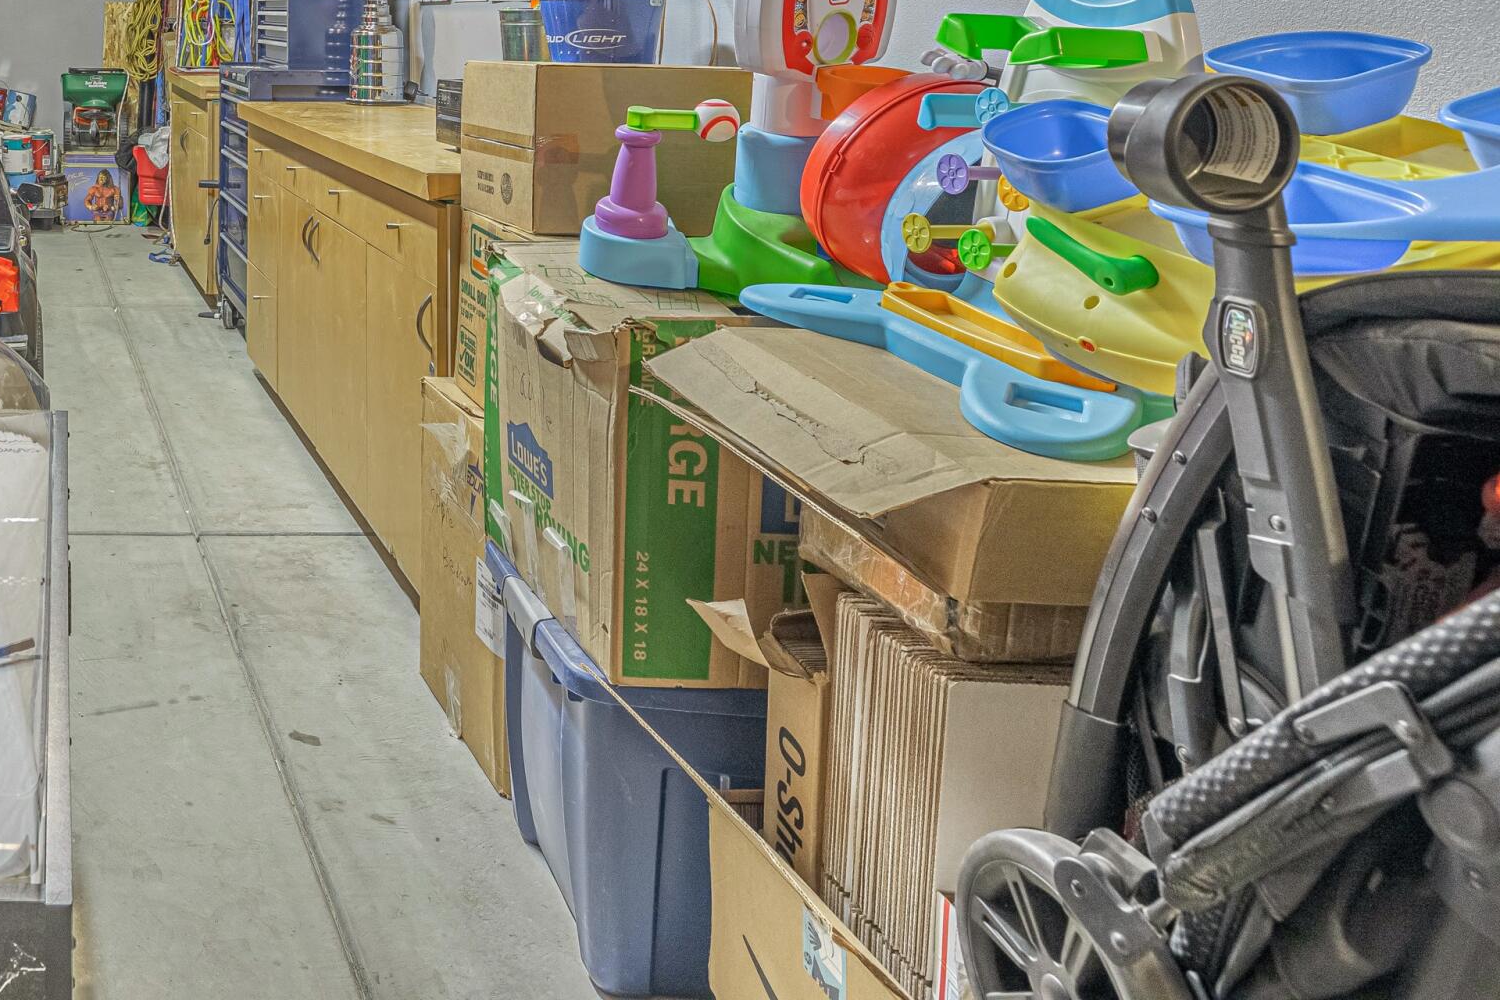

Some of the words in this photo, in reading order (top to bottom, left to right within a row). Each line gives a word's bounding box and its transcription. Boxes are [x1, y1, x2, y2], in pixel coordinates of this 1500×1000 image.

[573, 34, 627, 43] LIGHT
[465, 349, 475, 373] OK
[511, 431, 548, 488] LOWE'S
[636, 551, 650, 575] 24
[635, 578, 649, 589] X
[634, 596, 648, 617] 18
[634, 623, 648, 634] X
[633, 641, 647, 661] 18
